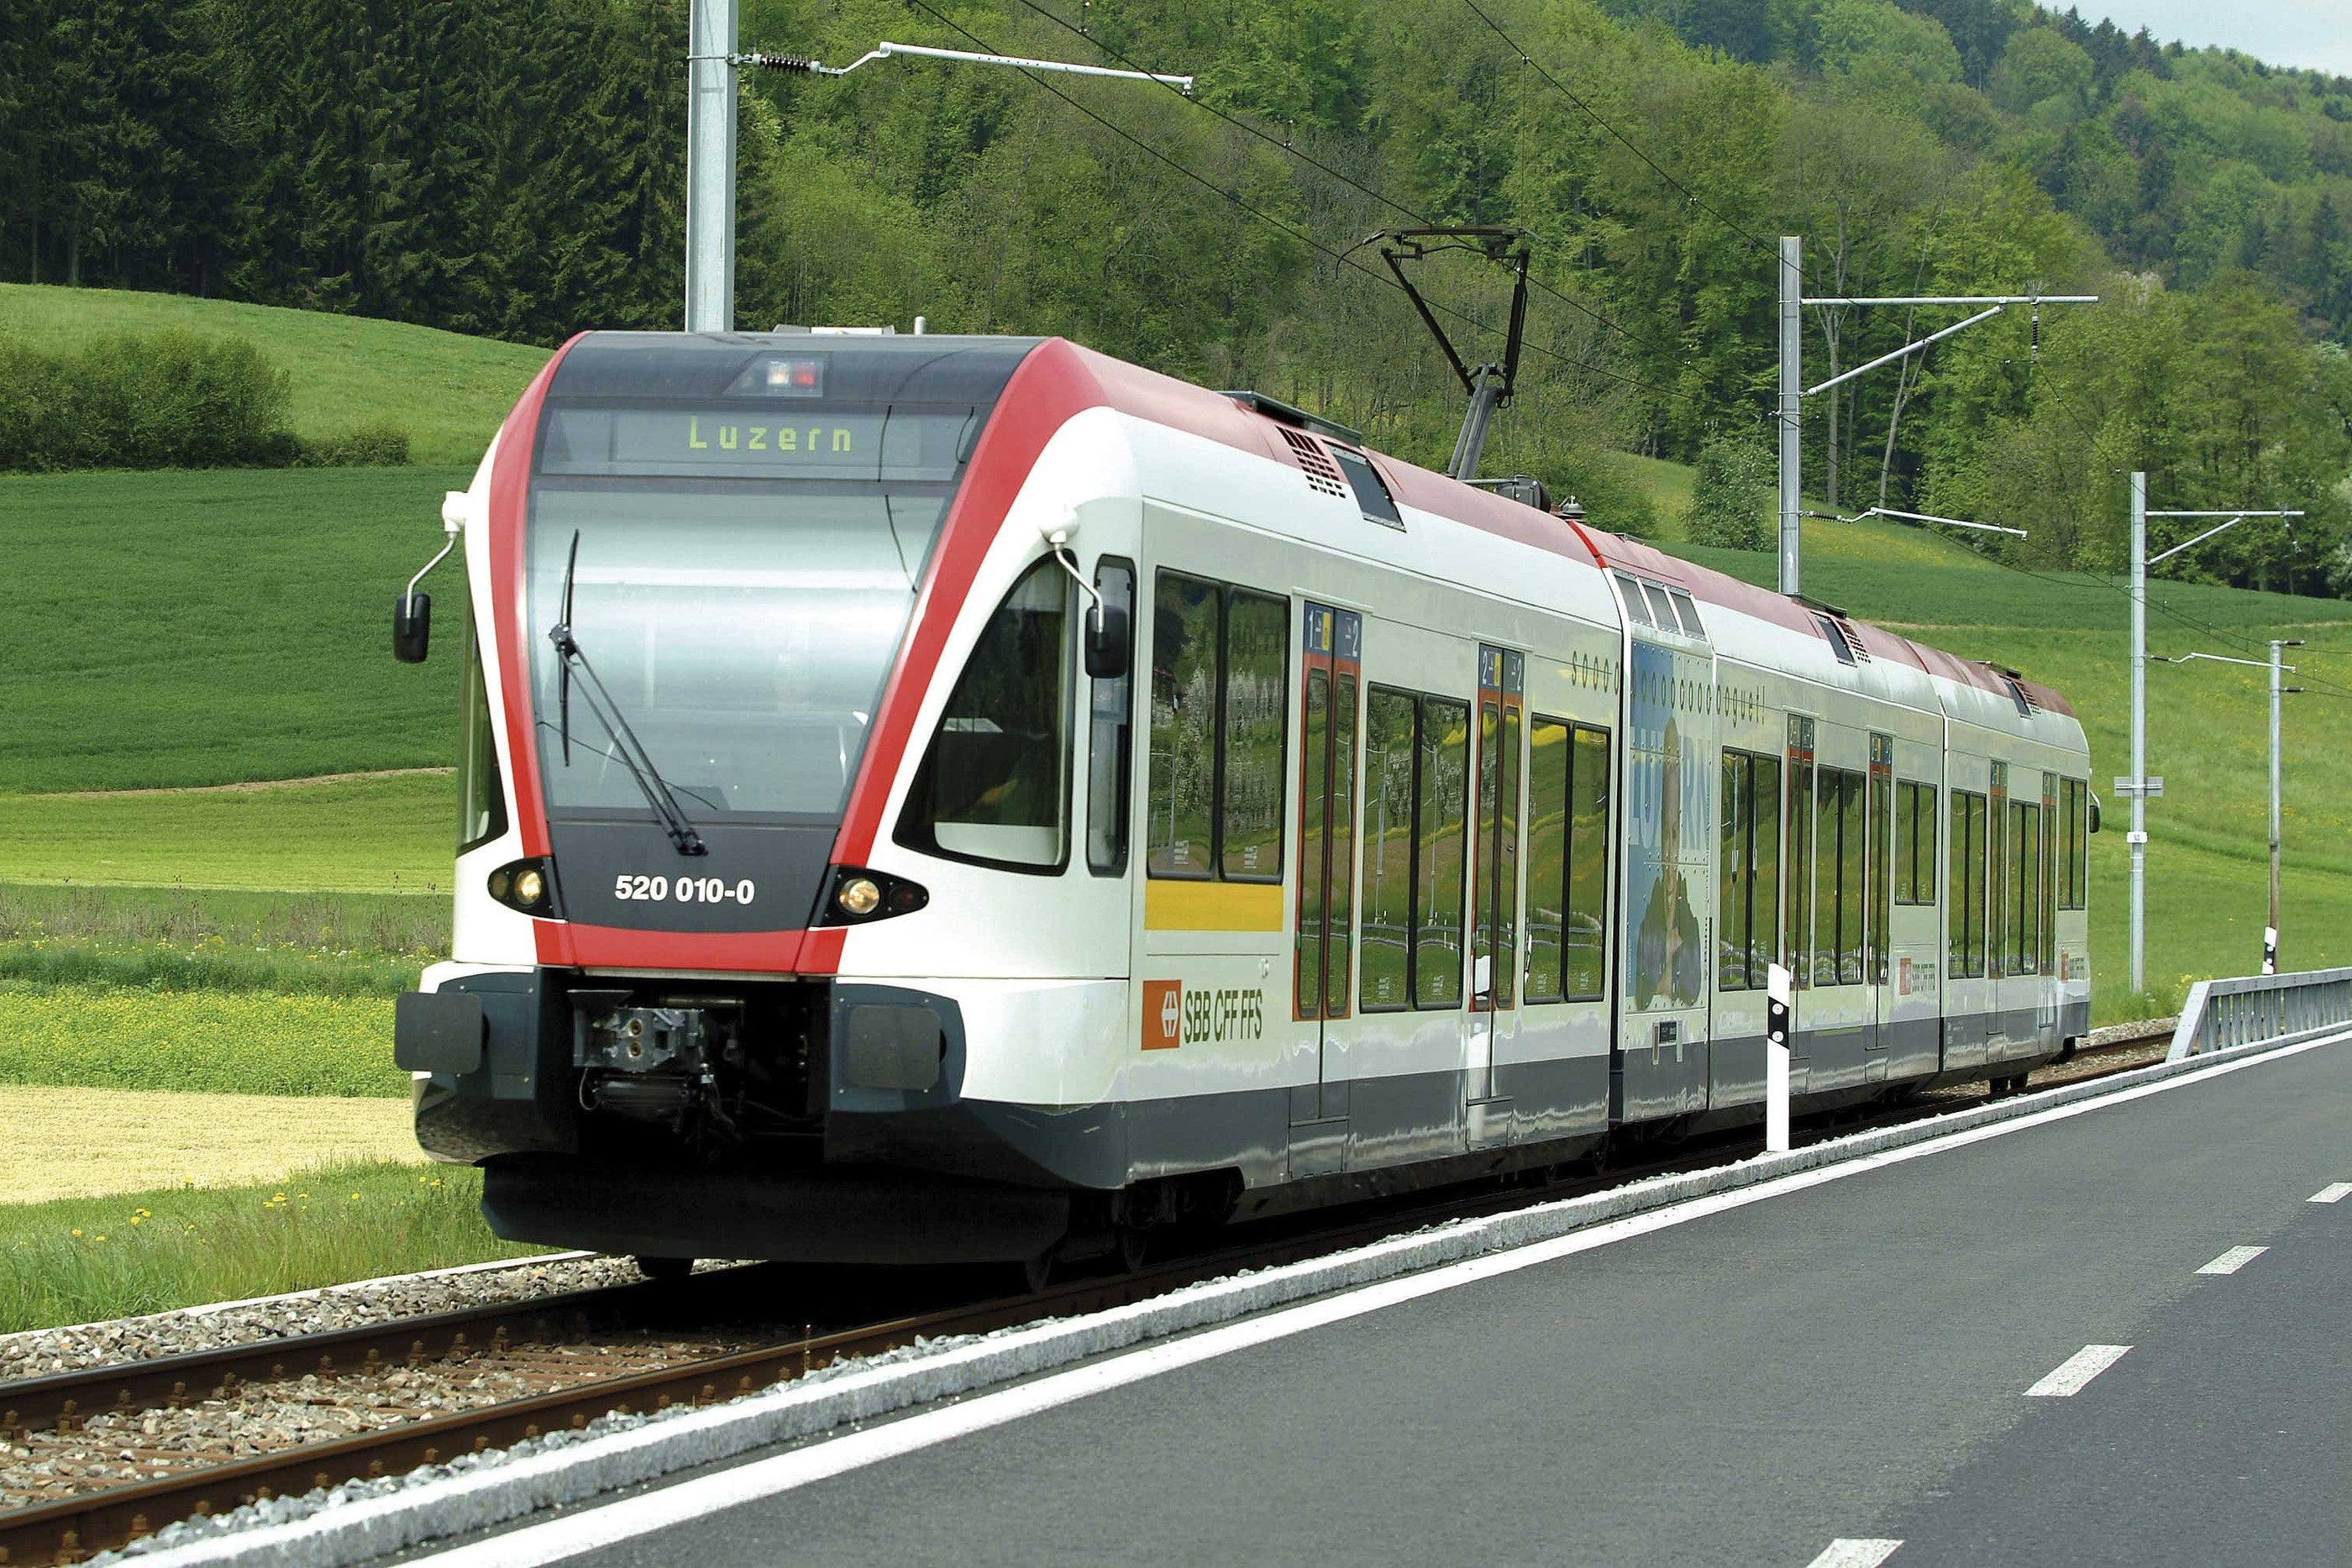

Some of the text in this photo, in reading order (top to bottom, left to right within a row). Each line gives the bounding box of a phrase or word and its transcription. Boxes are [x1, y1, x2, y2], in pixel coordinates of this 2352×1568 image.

[689, 415, 852, 452] Luzern
[1352, 620, 1359, 658] 2
[1482, 651, 1488, 685] 2
[1516, 658, 1523, 691] 2
[615, 875, 755, 905] 520 010-0
[1184, 988, 1263, 1044] SBB CFF FFS
